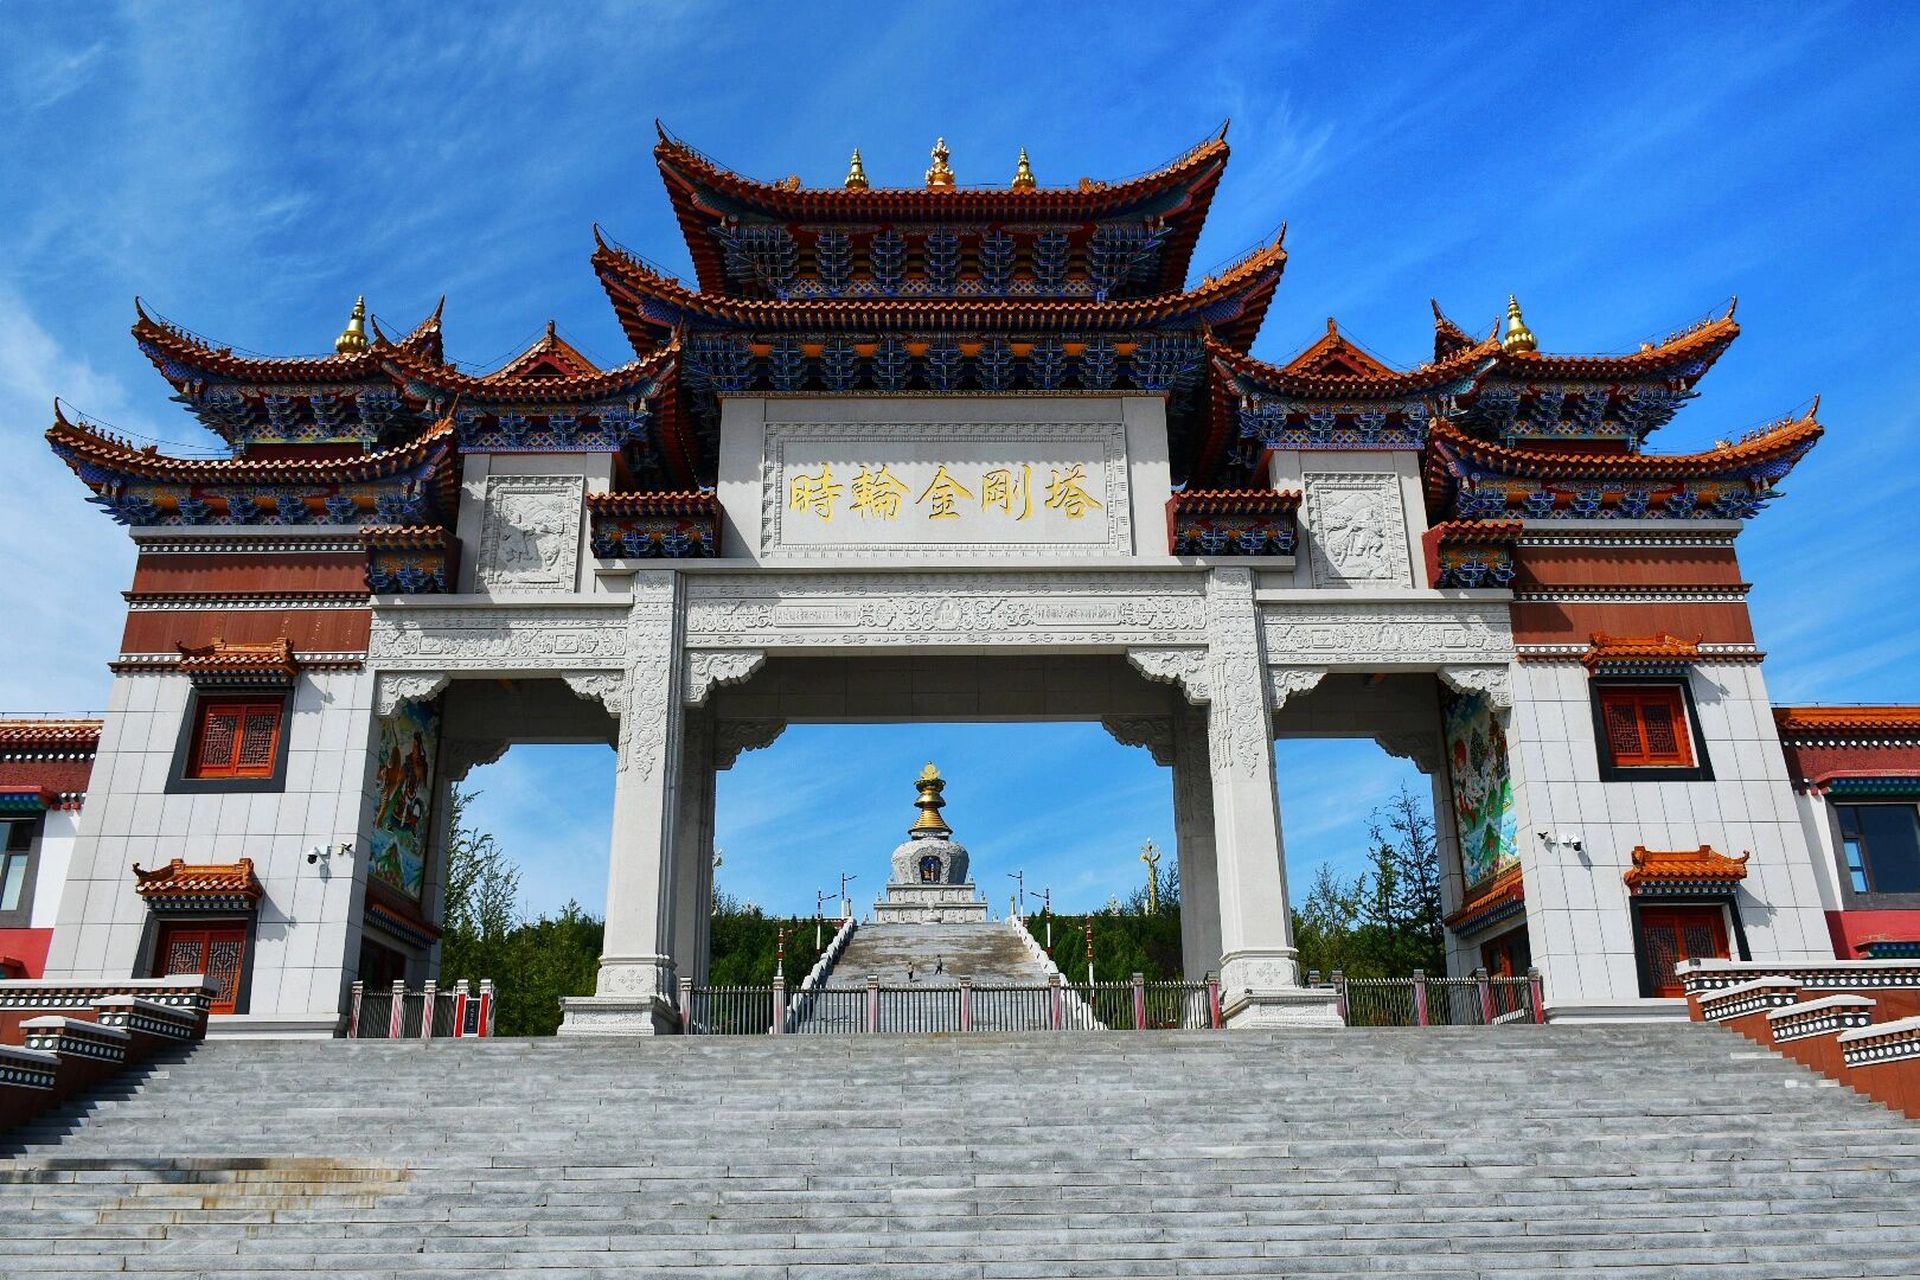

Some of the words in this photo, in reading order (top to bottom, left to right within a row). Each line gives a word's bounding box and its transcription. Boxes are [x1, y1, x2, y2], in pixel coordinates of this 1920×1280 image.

[789, 462, 1103, 522] 時輪金剛塔
